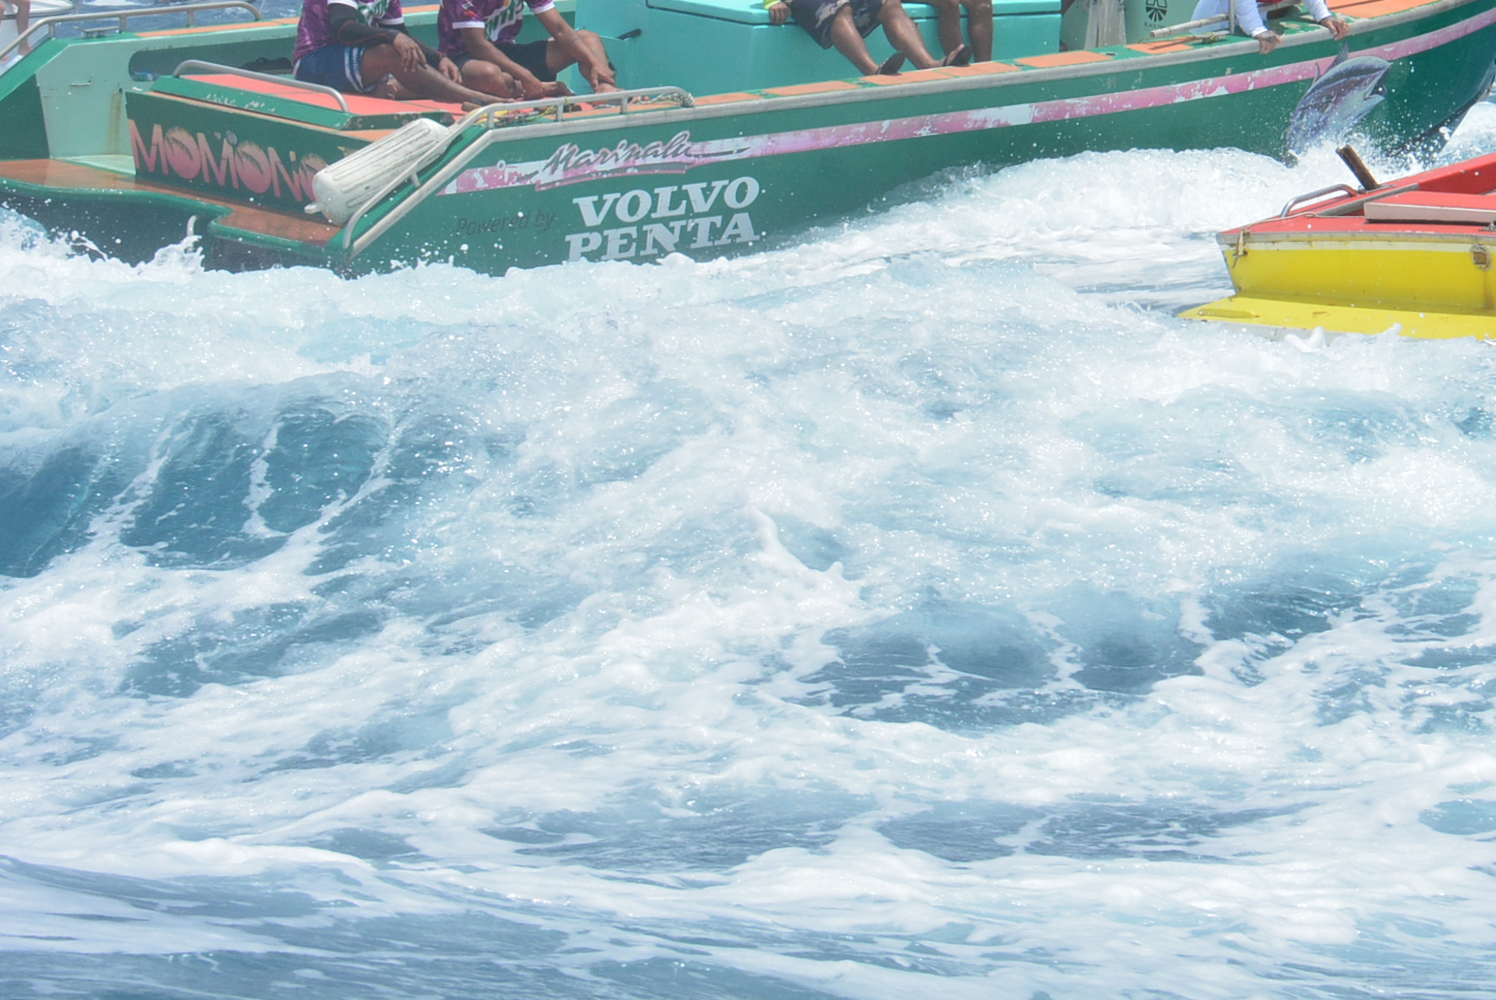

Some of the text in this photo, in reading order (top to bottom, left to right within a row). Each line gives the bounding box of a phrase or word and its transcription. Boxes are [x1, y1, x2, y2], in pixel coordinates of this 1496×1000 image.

[456, 208, 556, 238] Powered by
[572, 176, 760, 227] VOLVO
[564, 212, 760, 261] PENTA
